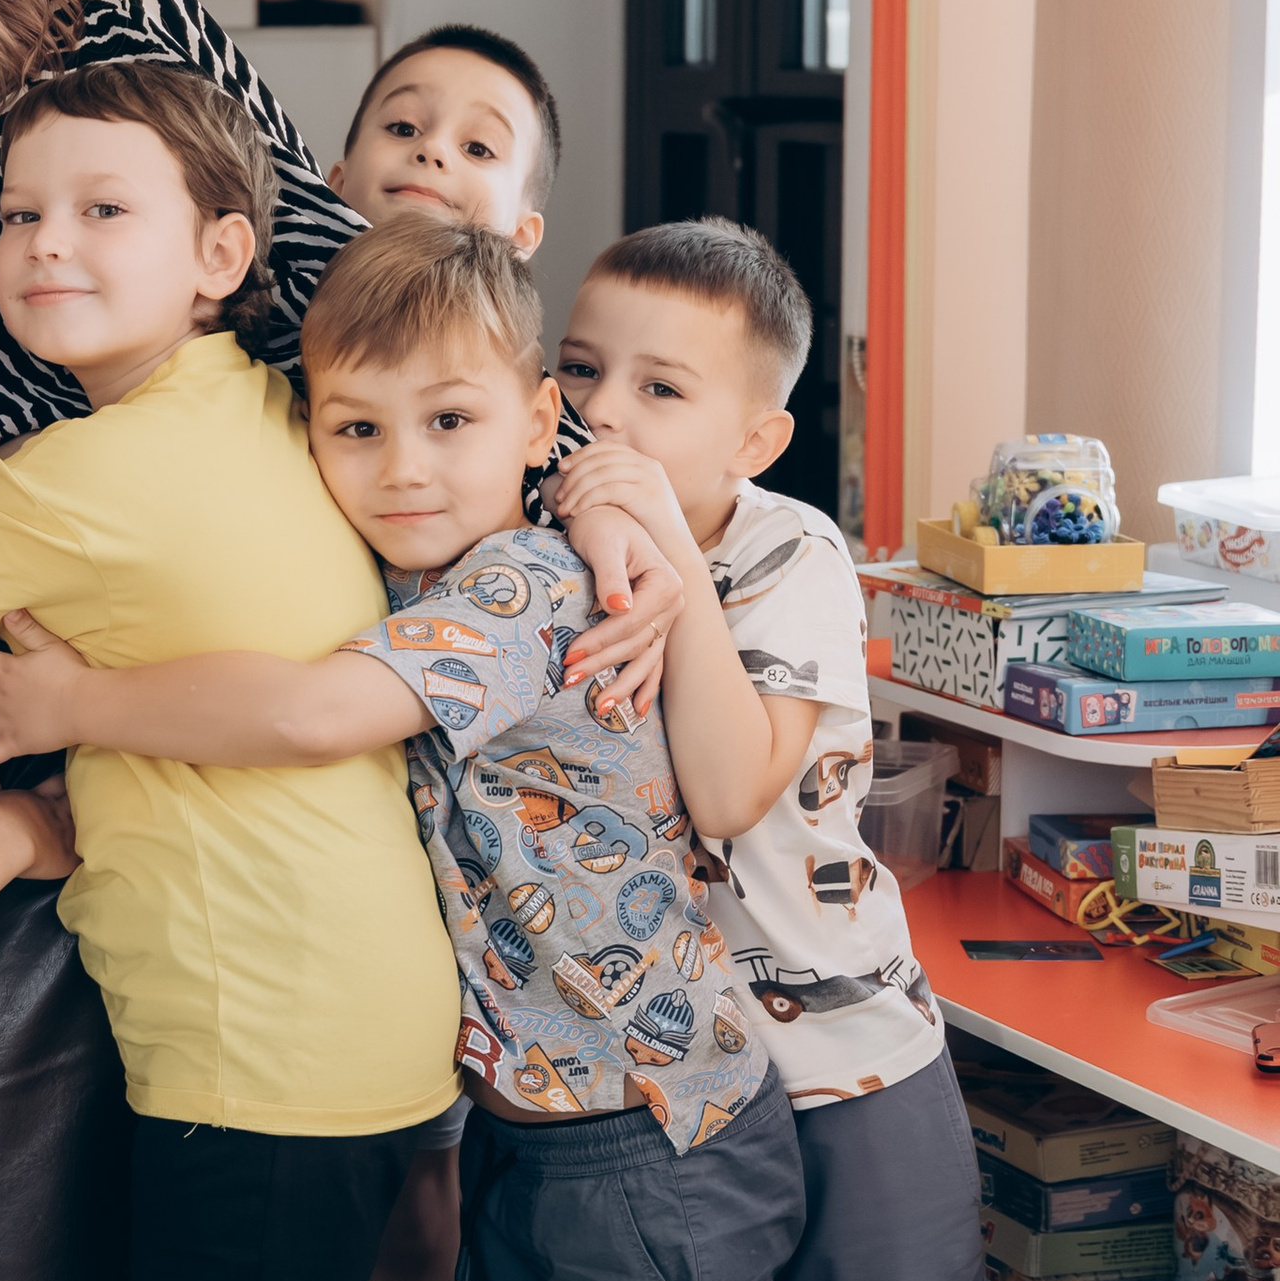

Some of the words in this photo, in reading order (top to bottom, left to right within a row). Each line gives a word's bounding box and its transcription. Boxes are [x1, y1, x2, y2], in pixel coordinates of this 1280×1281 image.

[1144, 636, 1181, 656] ИГРА
[486, 622, 537, 721] Leagu
[1186, 657, 1207, 667] ДЛЯ
[767, 669, 789, 684] 82
[533, 716, 644, 785] Leagu
[480, 772, 500, 785] BUT
[577, 773, 600, 785] BUT
[486, 786, 513, 798] LOUD
[622, 873, 674, 904] CHAMPION
[1192, 884, 1219, 898] GRANNA
[628, 888, 659, 912] 23
[618, 902, 647, 938] NUMBER
[625, 983, 641, 1002] CLUB
[625, 1024, 684, 1061] CHALLENGERS
[569, 1065, 589, 1077] BUT
